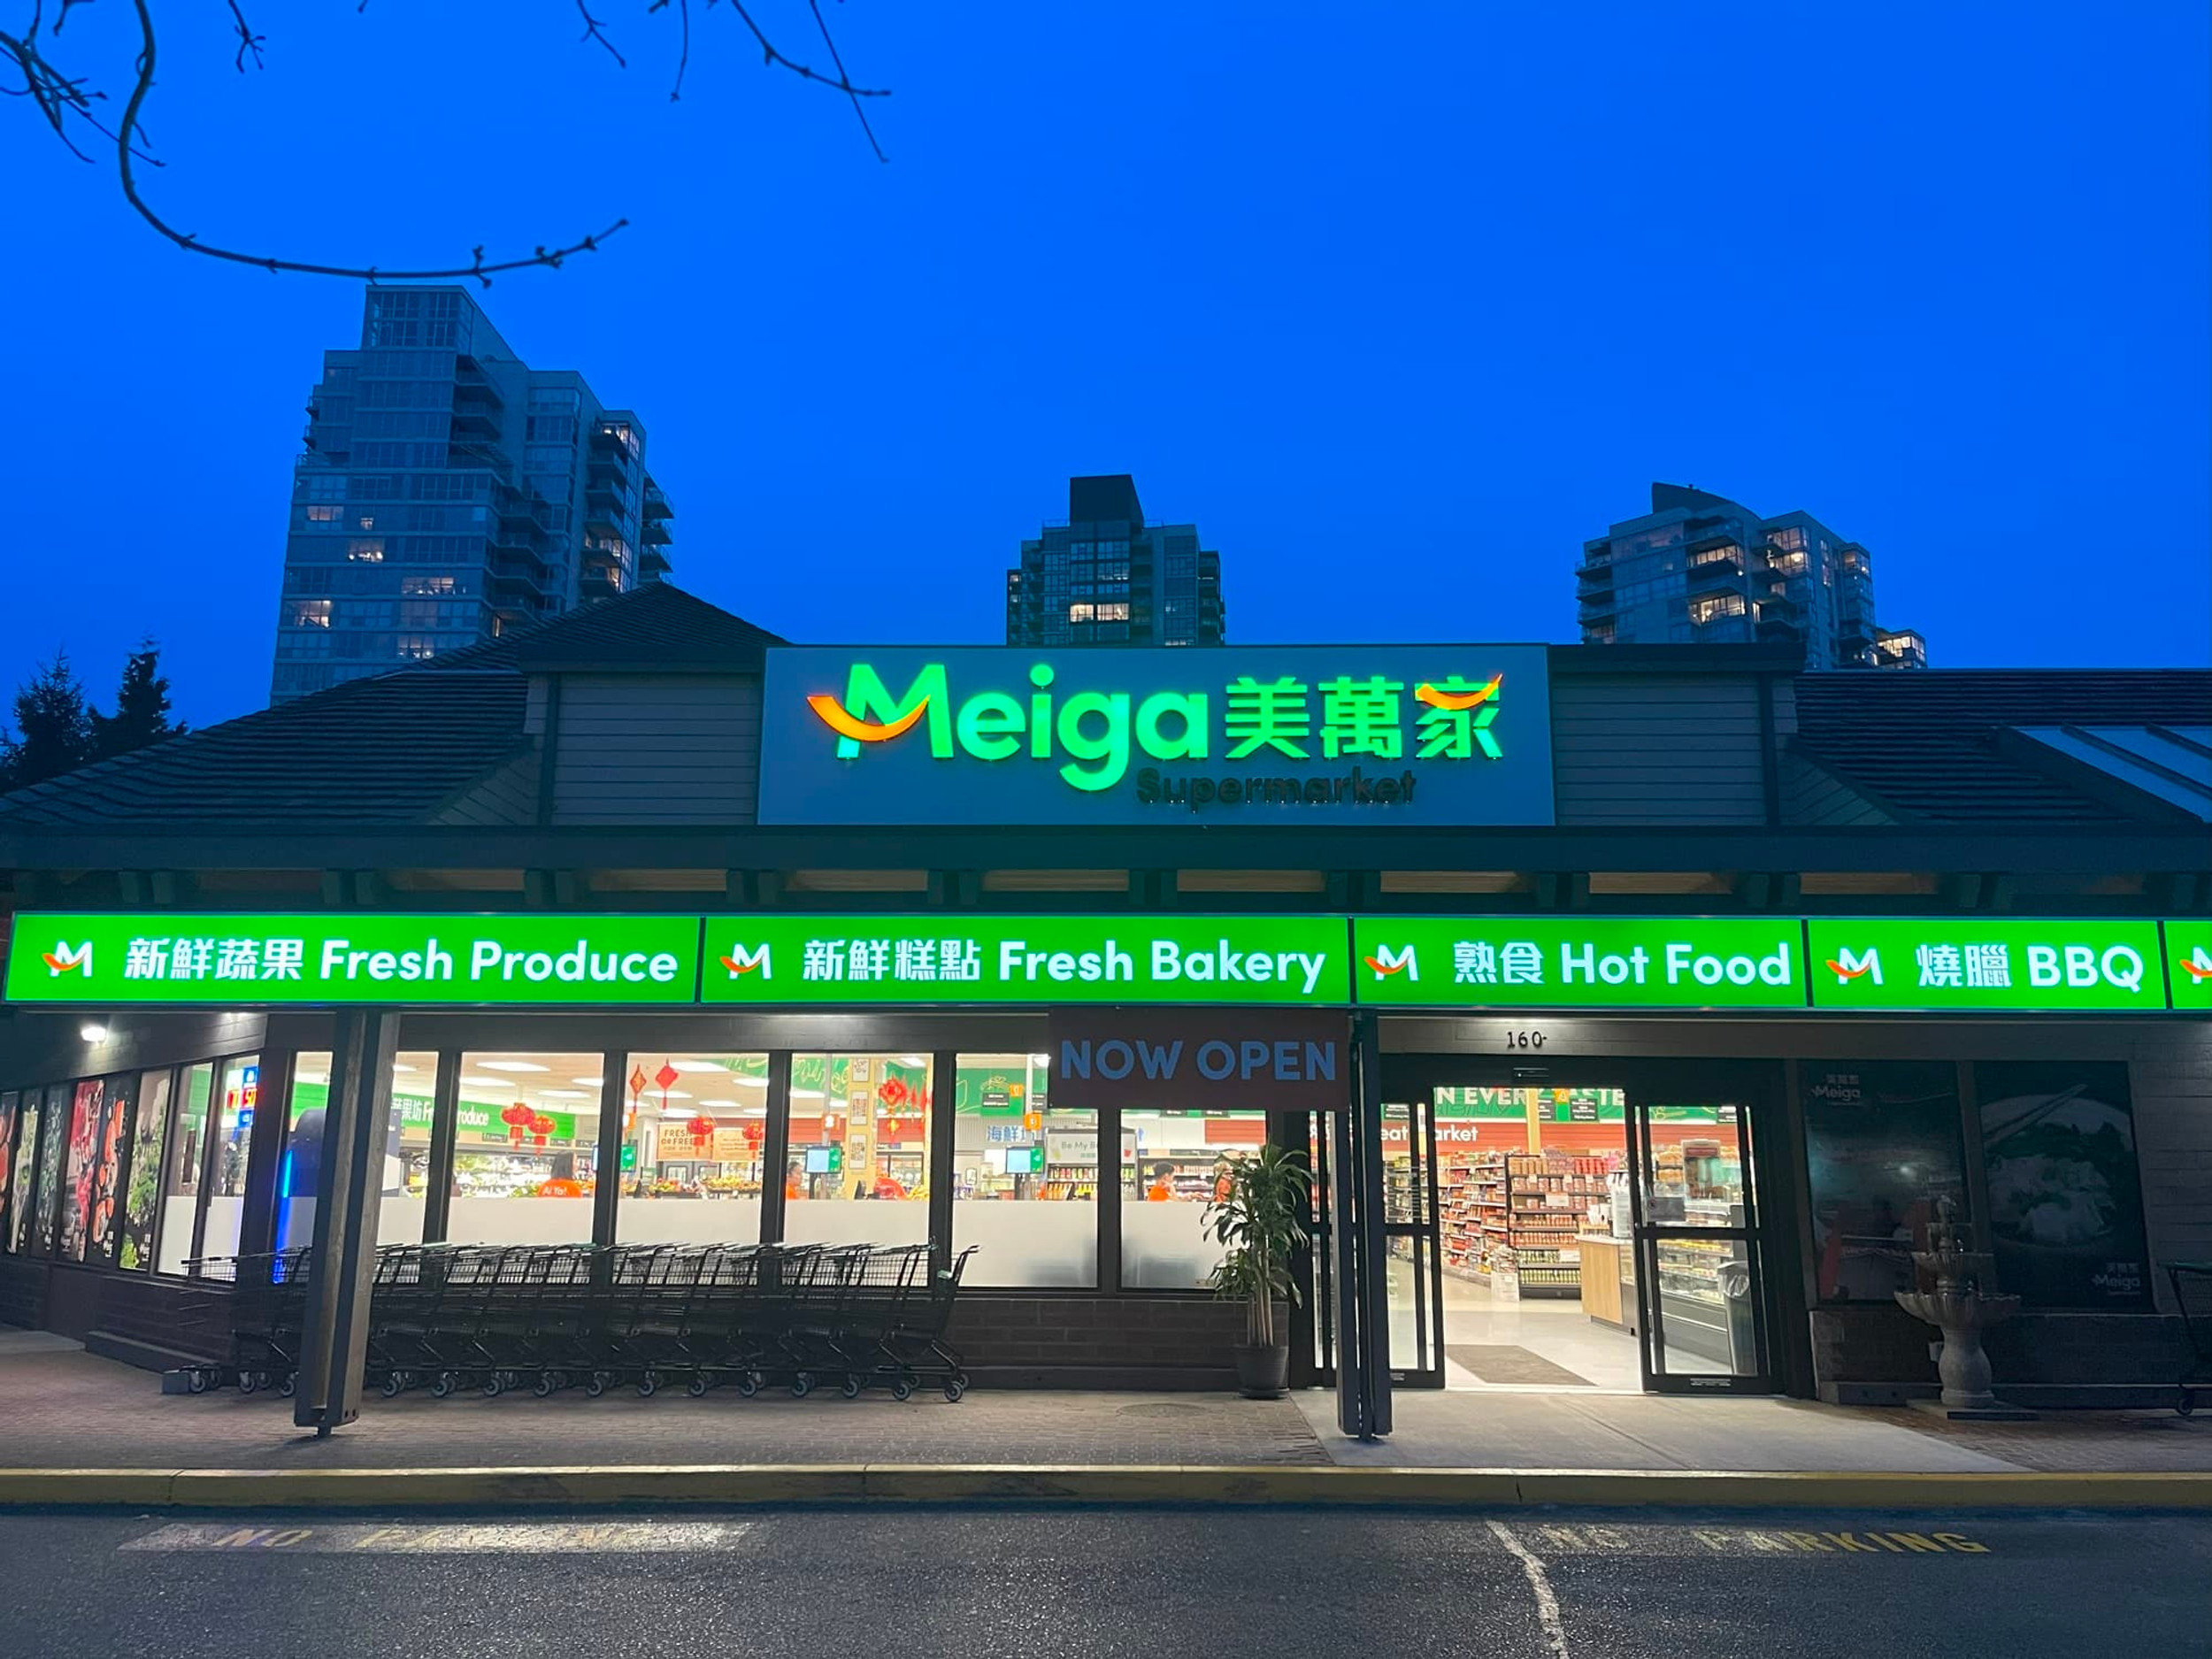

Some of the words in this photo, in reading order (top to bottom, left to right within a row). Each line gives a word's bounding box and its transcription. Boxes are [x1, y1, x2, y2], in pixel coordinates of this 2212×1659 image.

[809, 664, 1209, 791] Meiga
[1225, 674, 1504, 759] 美萬家
[1136, 765, 1417, 811] Supermarket
[124, 938, 303, 980] 新鮮蔬果
[320, 939, 452, 980] Fresh
[471, 940, 678, 982] Produce
[803, 939, 981, 981] 新鮮糕點
[1000, 940, 1133, 981] Fresh
[1152, 939, 1325, 994] Bakery
[1454, 941, 1542, 984] 熟食
[1562, 943, 1649, 984] Hot
[1666, 942, 1791, 985] Food
[1916, 944, 2011, 987] 燒臘
[2027, 945, 2144, 992] BBQ
[1061, 1041, 1181, 1080] NOW
[1198, 1041, 1334, 1080] OPEN
[1507, 1031, 1543, 1048] 160
[1463, 1087, 1543, 1105] EVER
[1810, 1085, 1861, 1102] Meiga
[457, 1106, 489, 1125] roduce
[1380, 1125, 1409, 1141] eat
[1434, 1123, 1479, 1141] arket
[2090, 1273, 2141, 1291] Meiga
[211, 1529, 312, 1548] NO
[1693, 1529, 1991, 1554] PARKING
